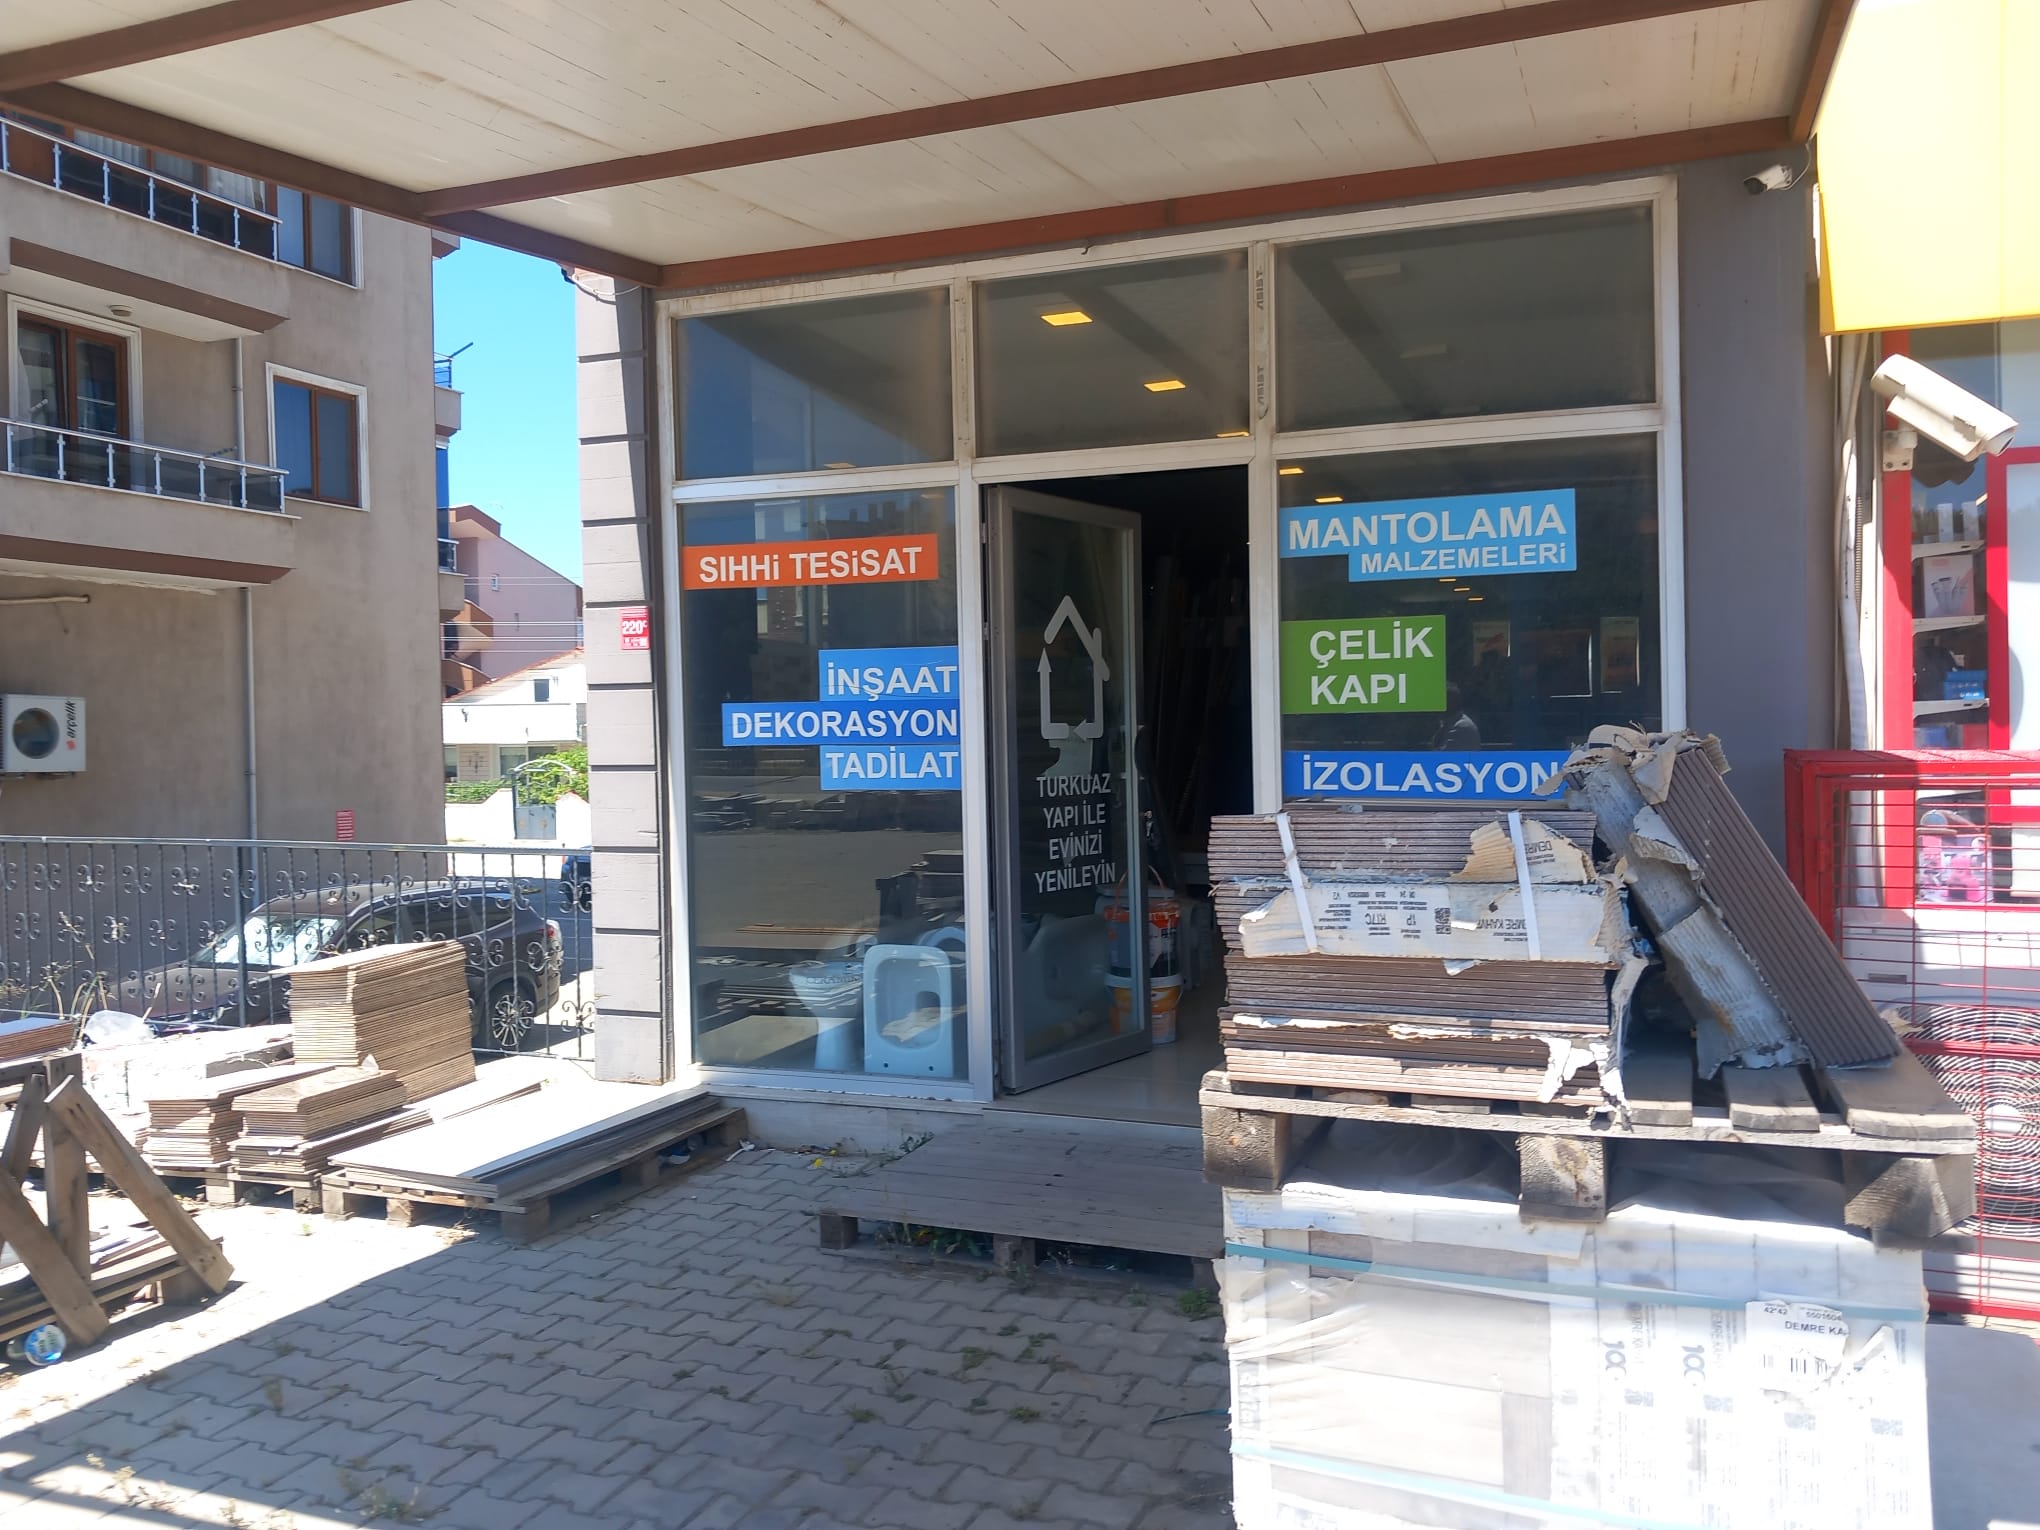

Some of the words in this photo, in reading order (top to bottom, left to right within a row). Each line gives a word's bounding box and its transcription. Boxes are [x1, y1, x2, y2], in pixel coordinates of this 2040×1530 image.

[1289, 503, 1567, 550] MANTOLAMA
[699, 555, 780, 583] SIHHi
[788, 546, 922, 580] TESiSAT
[1360, 542, 1567, 574] MALZEMELERi
[1309, 621, 1433, 669] ÇELİK
[827, 662, 958, 702] İNŞAAT
[1310, 673, 1407, 706] KAPI
[732, 709, 958, 740] DEKORASYON
[825, 746, 959, 780] TADİLAT
[1303, 754, 1559, 794] İZOLASYON
[1043, 805, 1079, 829] YAPI
[1083, 800, 1106, 825] İLE
[1049, 829, 1103, 860] EVİNİZİ
[1035, 859, 1116, 893] YENİLEYİN
[1785, 1320, 1825, 1334] DEMRE
